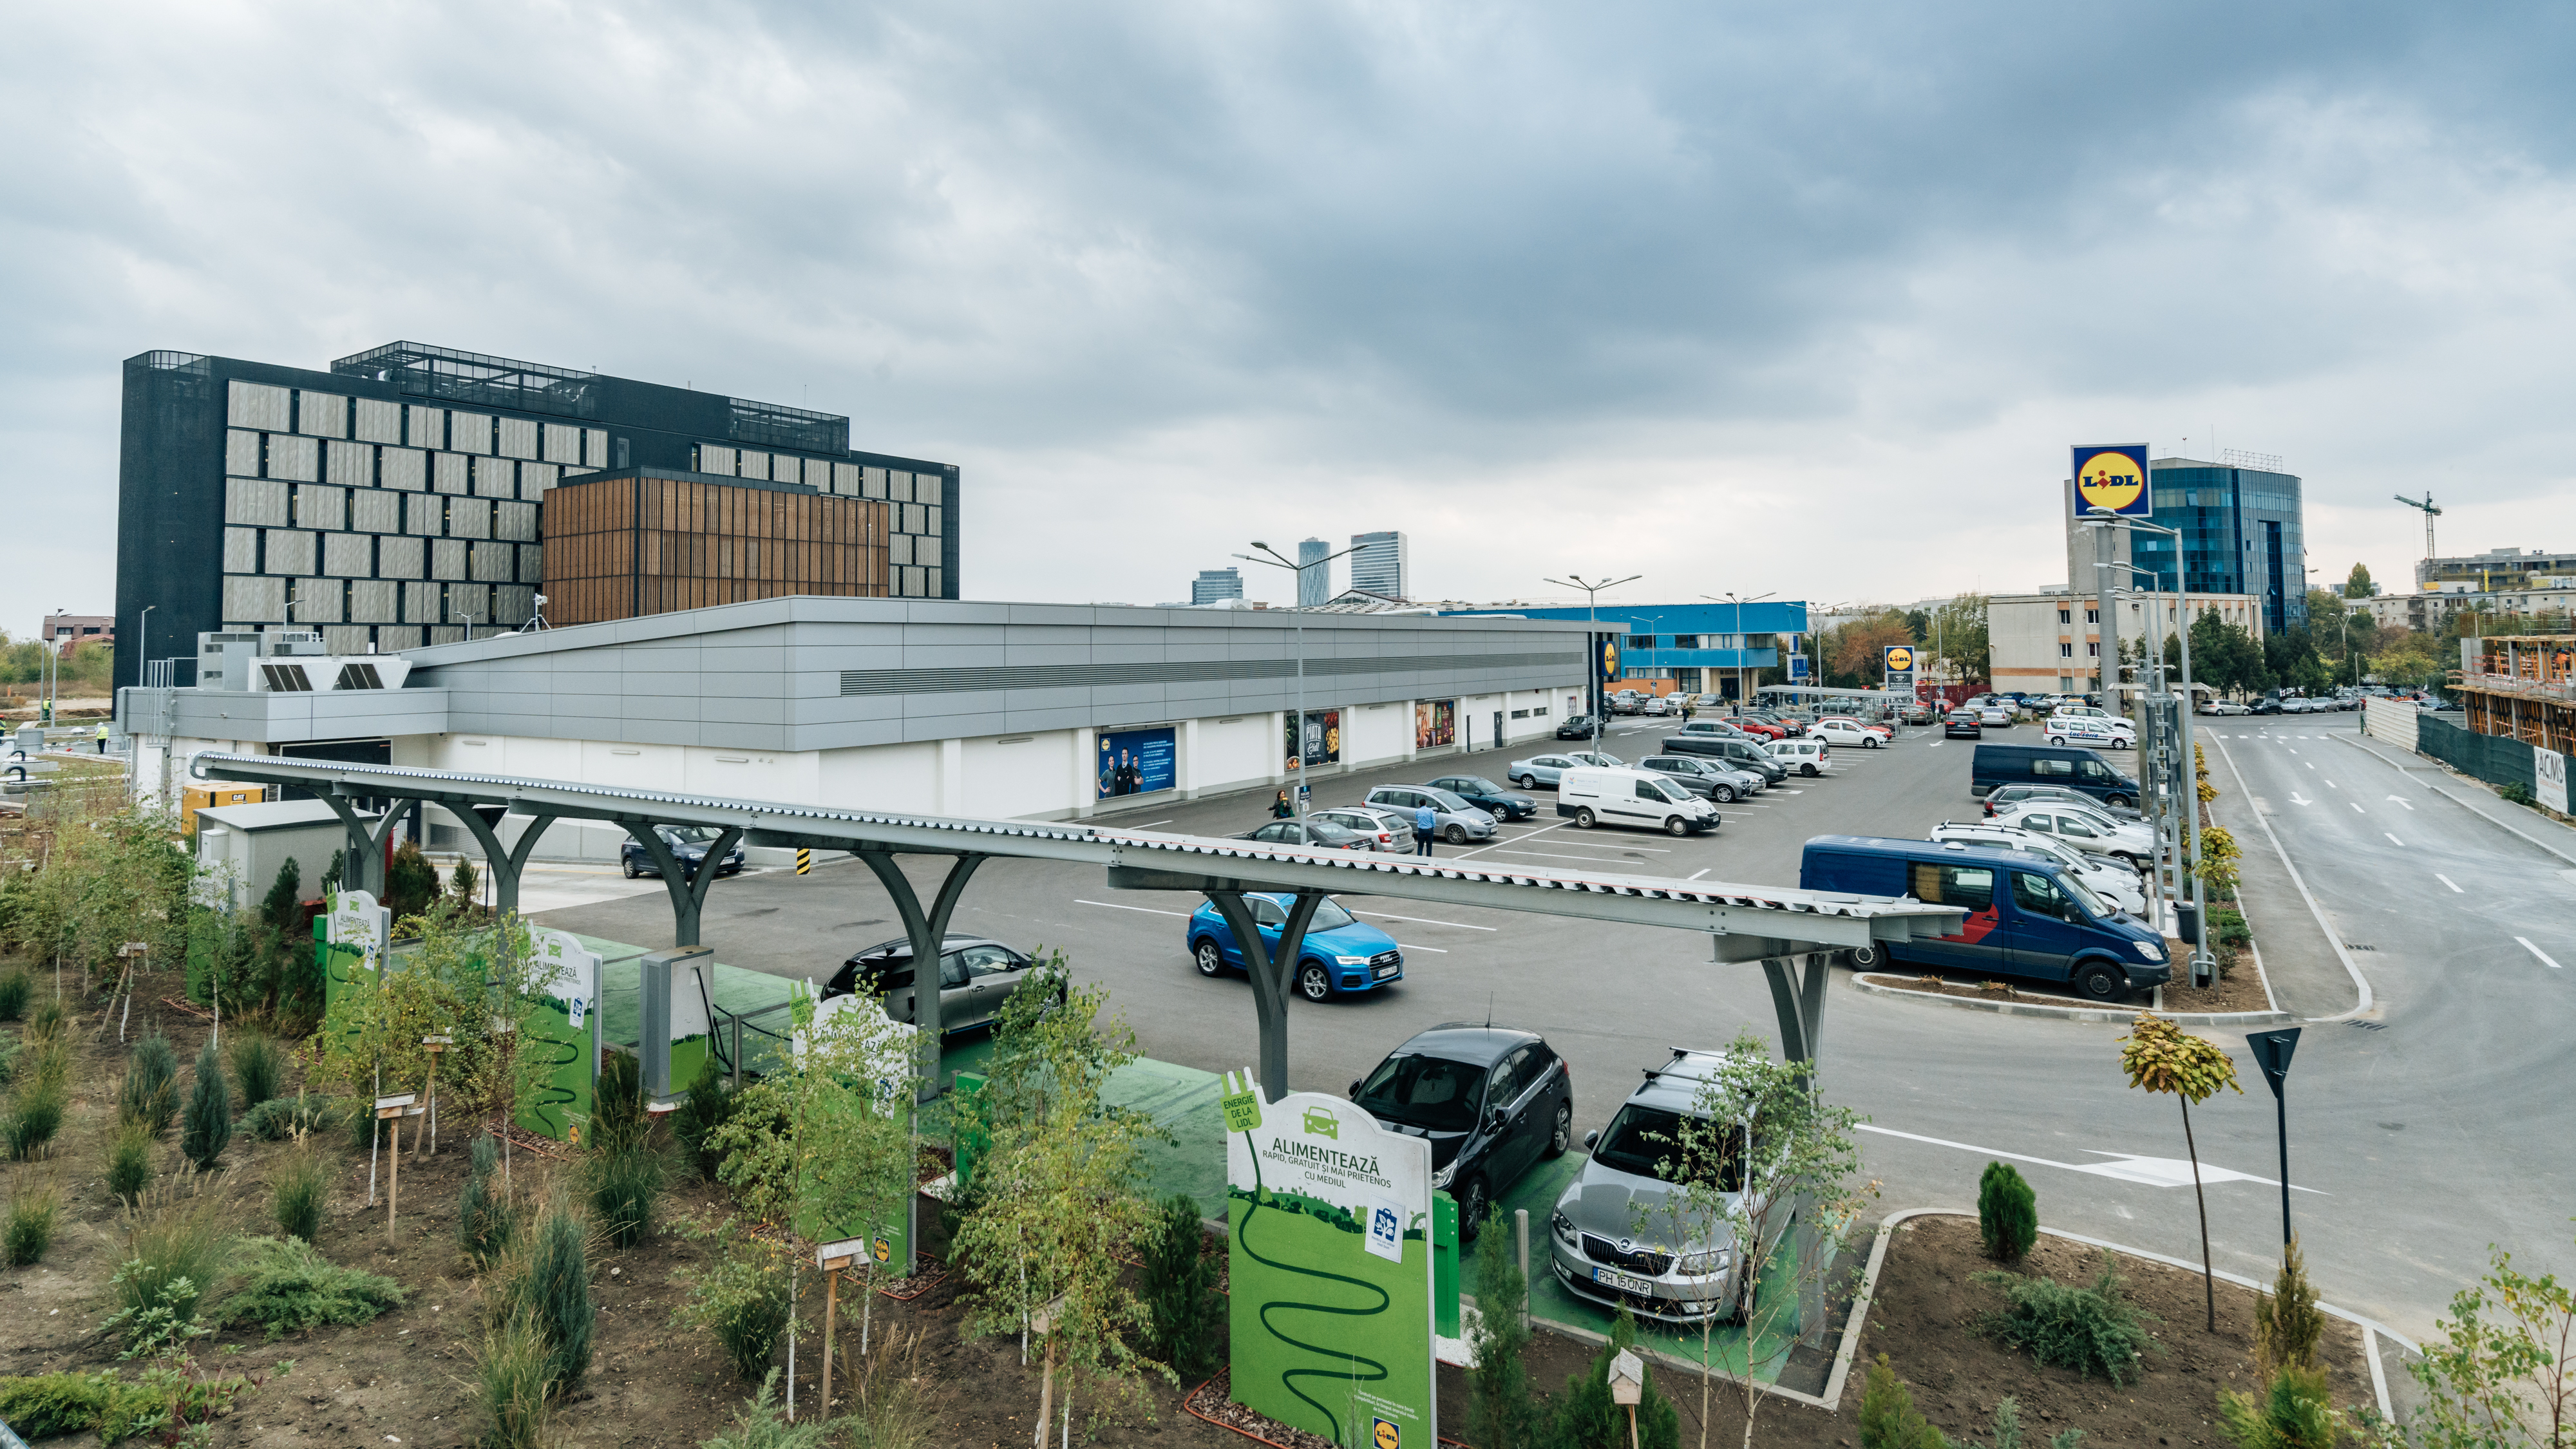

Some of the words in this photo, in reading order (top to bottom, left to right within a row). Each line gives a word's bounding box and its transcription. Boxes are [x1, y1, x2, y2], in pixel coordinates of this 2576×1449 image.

[1307, 743, 1320, 755] Lidl
[2539, 752, 2563, 784] ACMS
[1224, 1095, 1255, 1109] ENERGIE
[1231, 1109, 1242, 1118] DE
[1242, 1106, 1253, 1115] LA
[1236, 1117, 1253, 1128] LIDL
[1273, 1137, 1379, 1176] ALIMENTEAZĂ
[1263, 1150, 1287, 1164] RAPID,
[1289, 1157, 1320, 1171] GRATUIT
[1331, 1166, 1345, 1177] MAI
[1348, 1171, 1391, 1188] PRIETENOS
[1305, 1171, 1315, 1180] CU
[1317, 1173, 1346, 1188] MEDIUL
[1599, 1271, 1613, 1284] PH
[1617, 1276, 1626, 1287] 15
[1627, 1278, 1649, 1294] UNR
